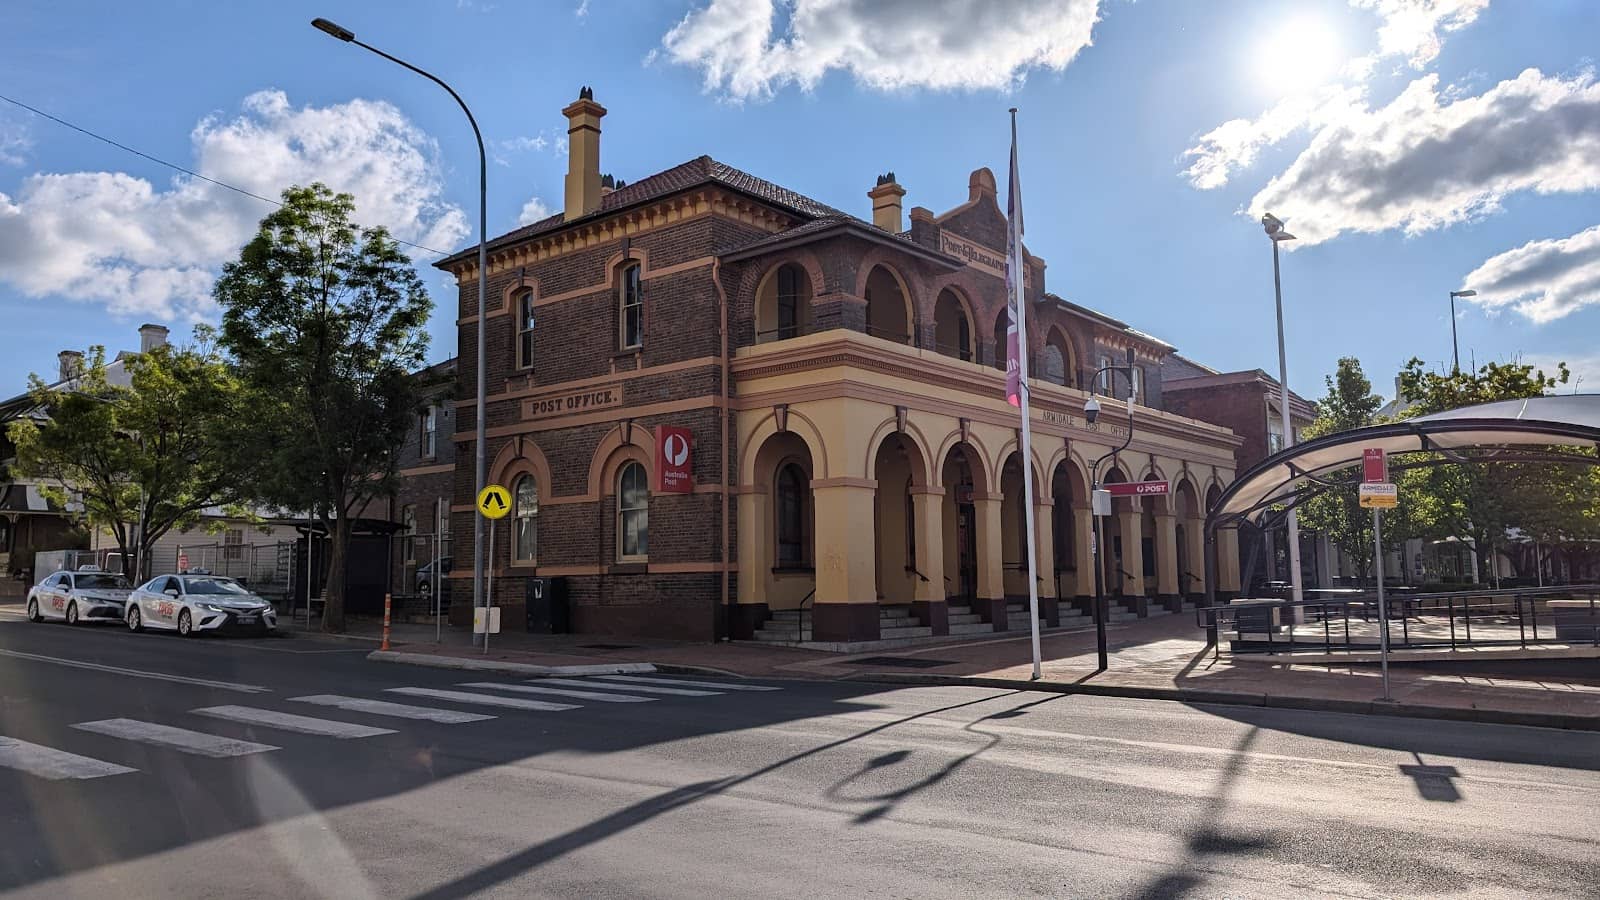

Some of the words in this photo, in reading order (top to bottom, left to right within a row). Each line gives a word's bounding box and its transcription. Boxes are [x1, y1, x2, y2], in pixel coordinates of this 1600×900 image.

[532, 399, 563, 415] POST
[567, 390, 618, 409] OFFICE.
[1042, 410, 1074, 425] ARMIDALE
[1110, 425, 1130, 438] OFFIC
[664, 470, 688, 479] Australia
[664, 478, 677, 486] Post
[1144, 484, 1166, 492] POST
